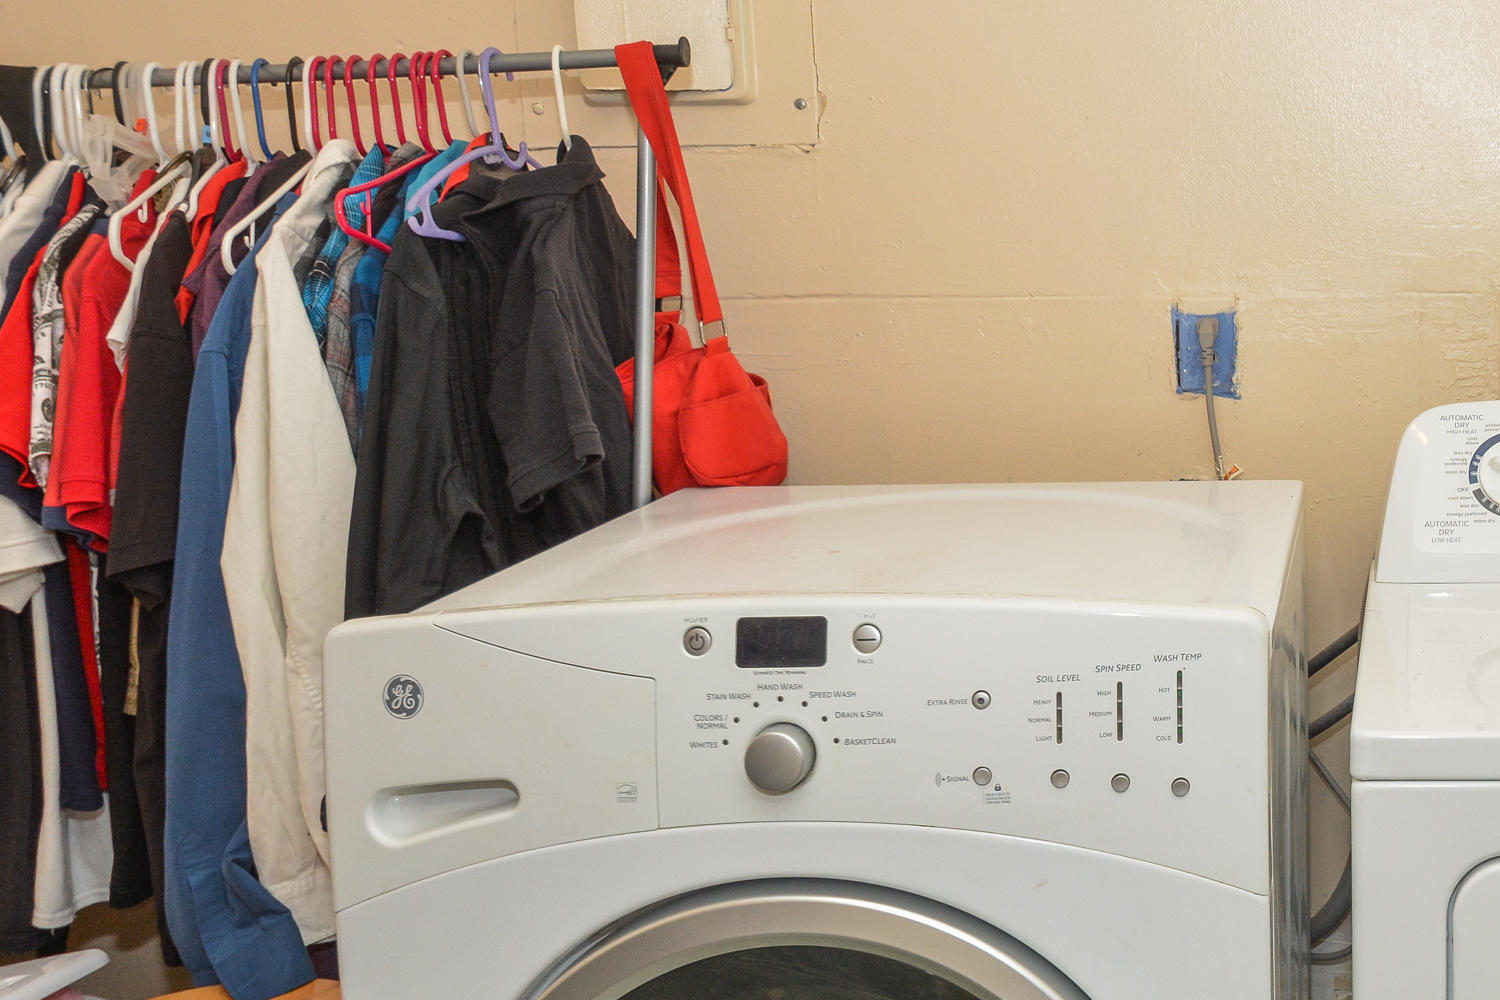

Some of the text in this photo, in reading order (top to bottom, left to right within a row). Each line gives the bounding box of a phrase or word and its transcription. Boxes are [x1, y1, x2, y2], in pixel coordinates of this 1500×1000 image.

[1153, 653, 1202, 663] WASH TEMP
[1096, 663, 1142, 673] SPIN SPEED
[1036, 674, 1081, 683] SOIL LEVEL
[707, 693, 727, 701] STAIN
[809, 691, 832, 699] SPEED
[845, 738, 896, 746] BASKETCLEAN
